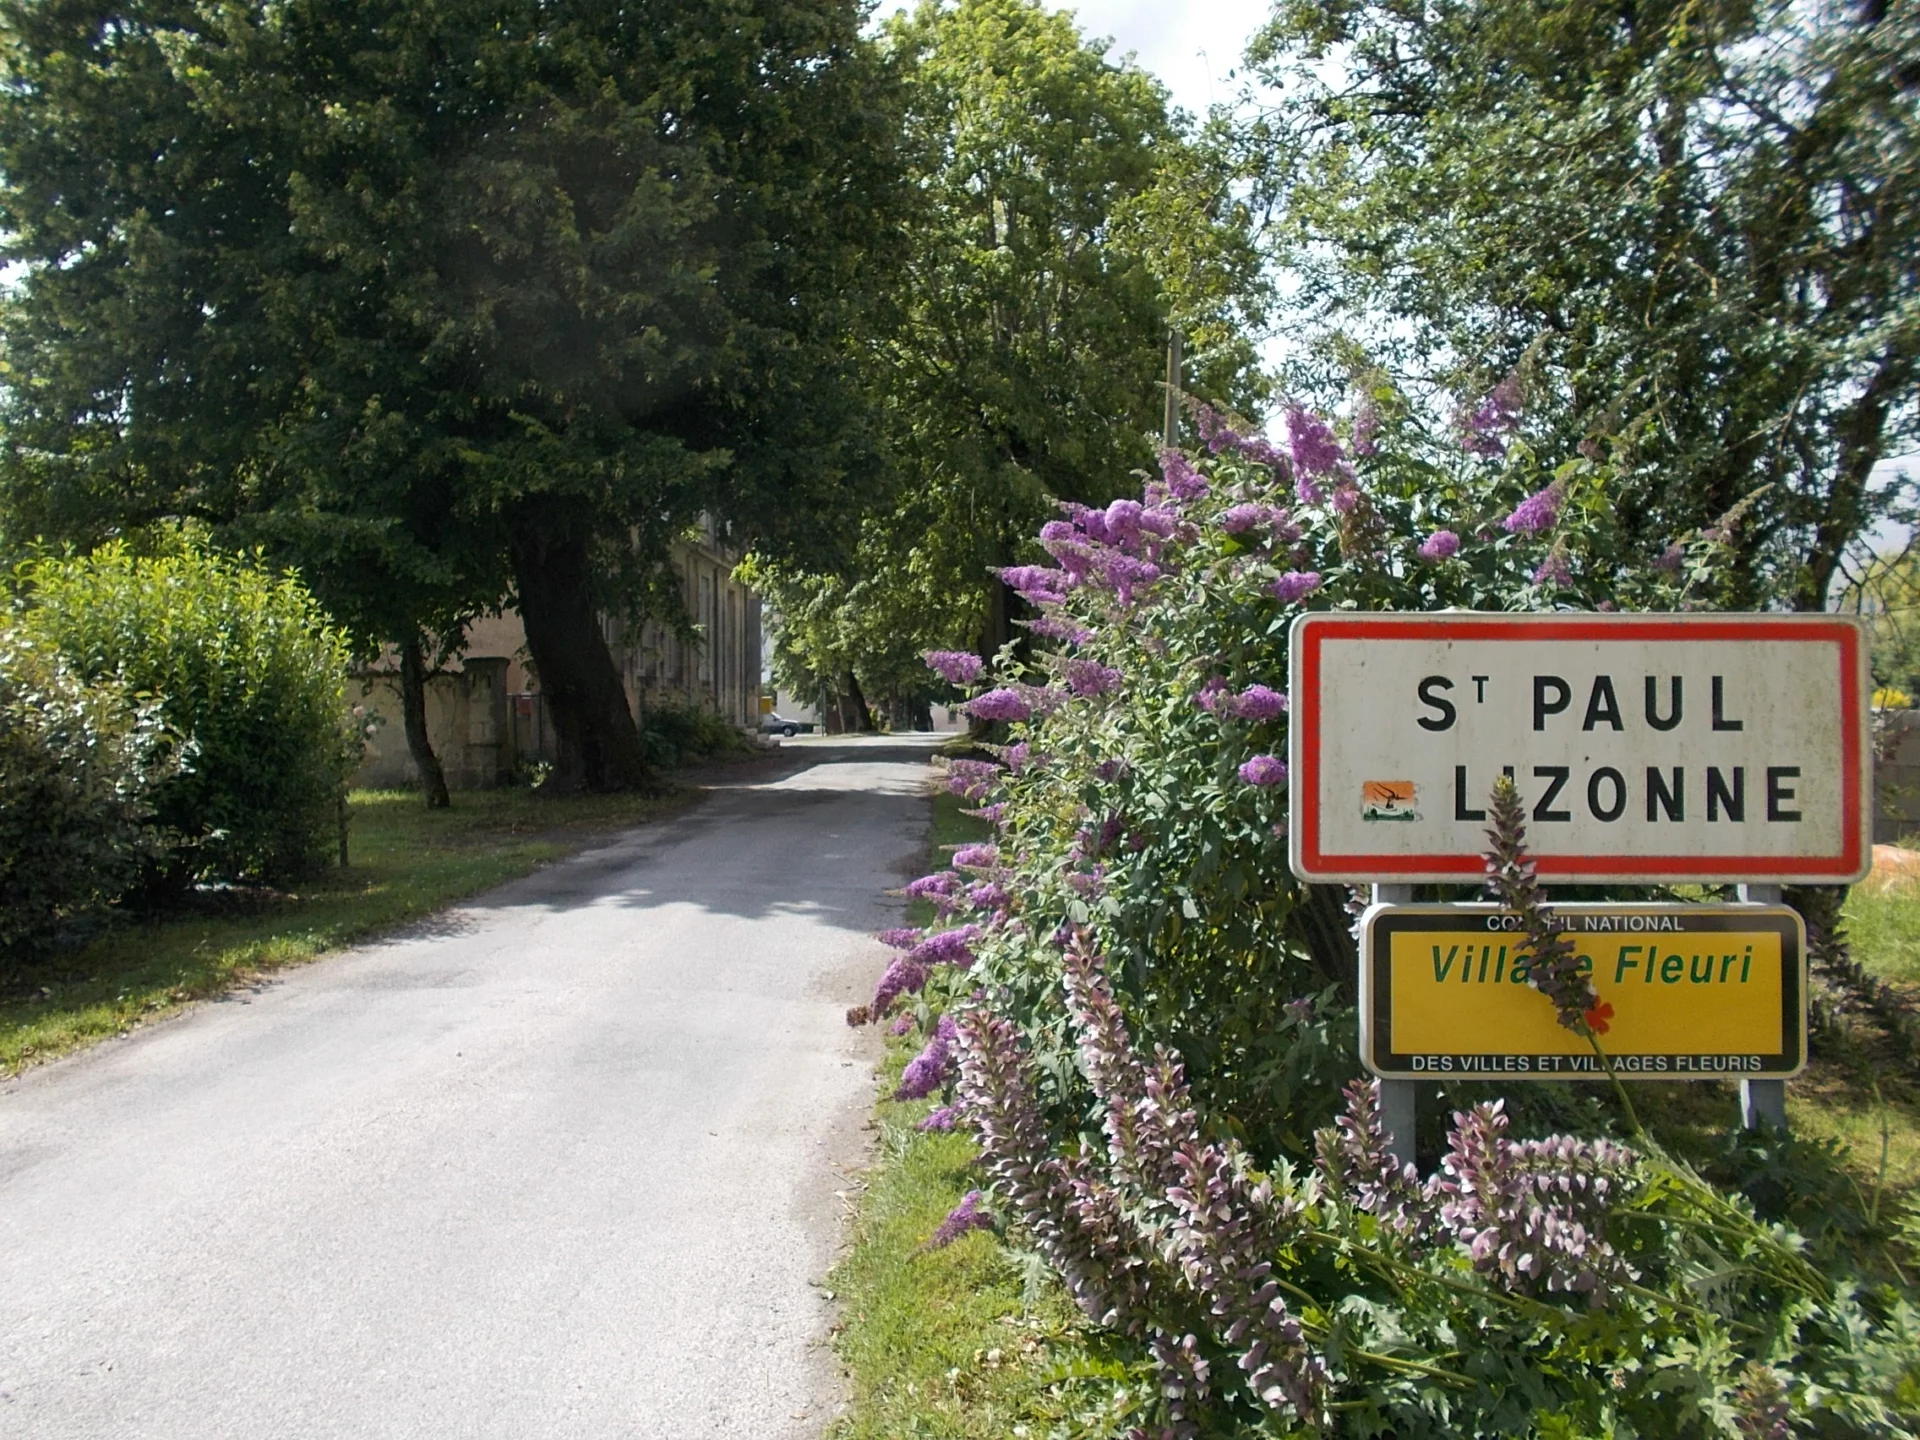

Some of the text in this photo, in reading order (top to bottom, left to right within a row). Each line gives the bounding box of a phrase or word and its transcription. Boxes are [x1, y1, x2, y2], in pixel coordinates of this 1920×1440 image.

[1532, 675, 1744, 732] PAUL
[1455, 764, 1803, 823] LZONNE
[1584, 915, 1684, 931] NATIONAL
[1431, 945, 1753, 985] Villae Fleuri
[1412, 1056, 1762, 1071] DES VILLES ET VILAGES FLEURIS
